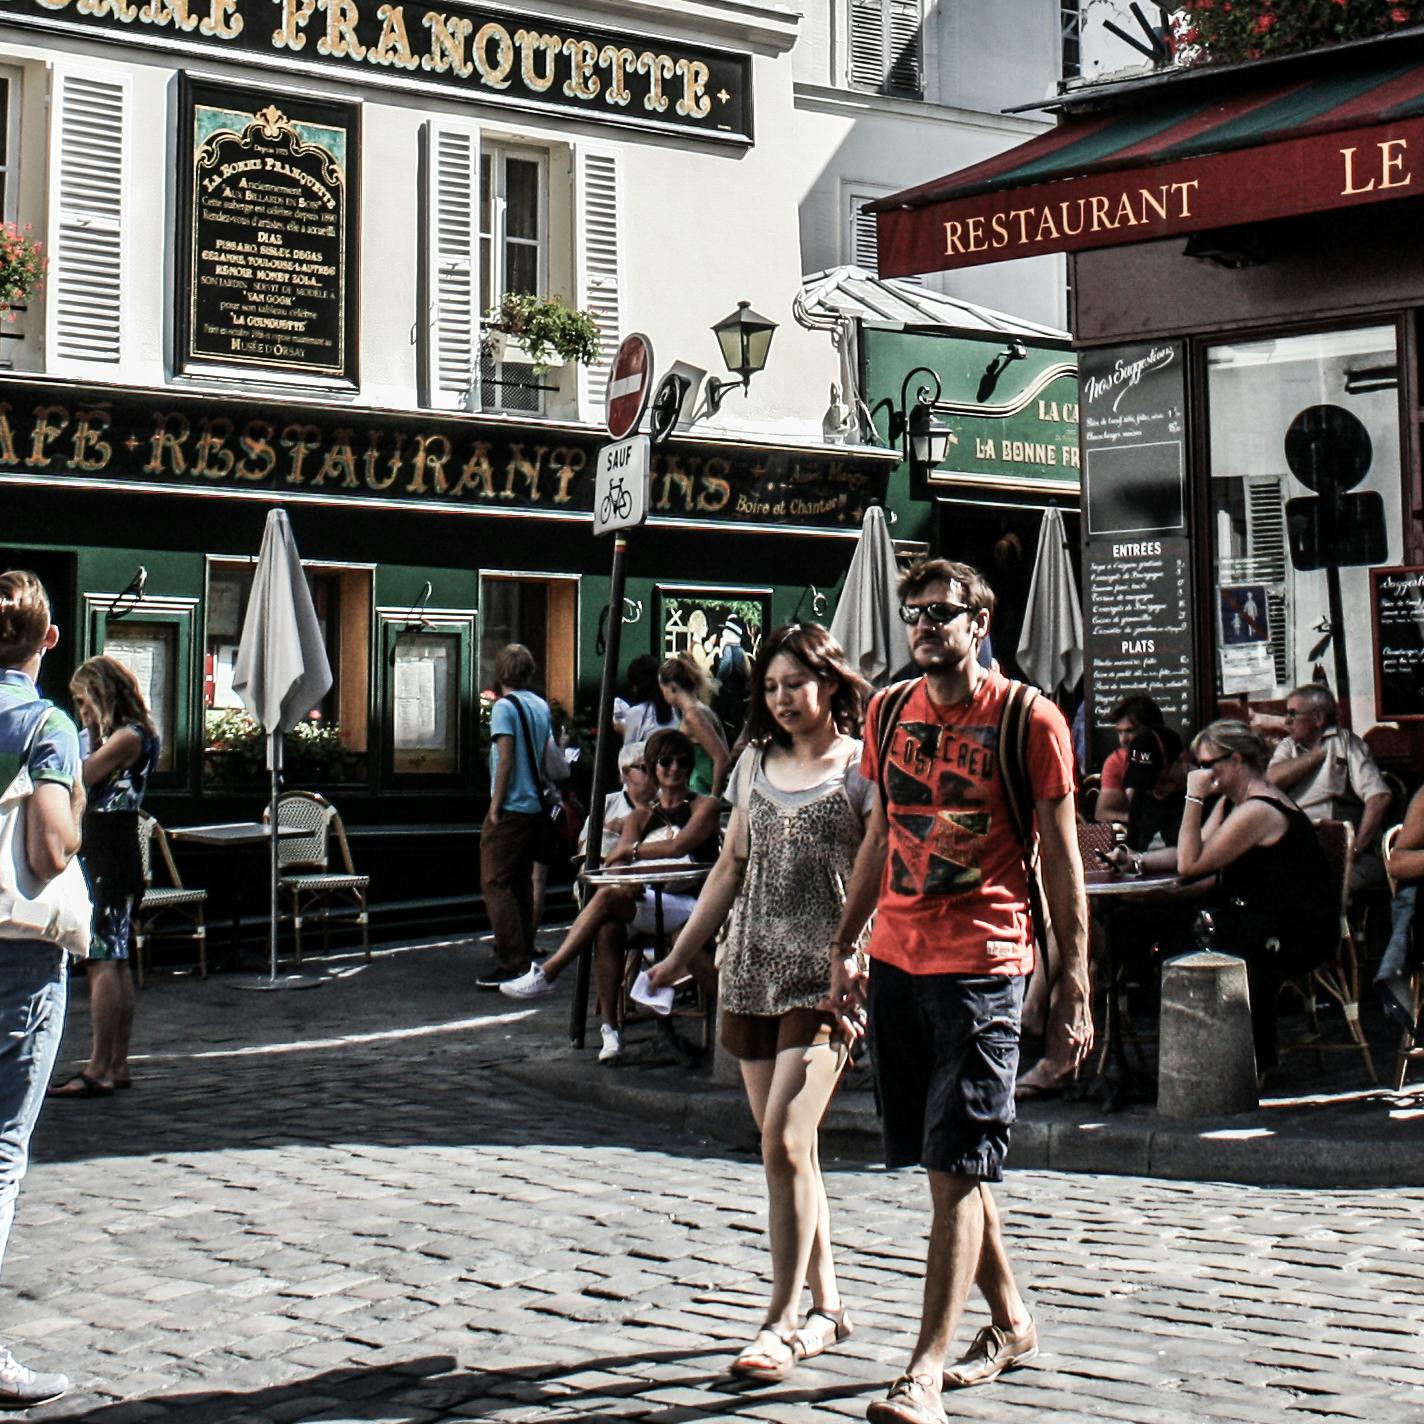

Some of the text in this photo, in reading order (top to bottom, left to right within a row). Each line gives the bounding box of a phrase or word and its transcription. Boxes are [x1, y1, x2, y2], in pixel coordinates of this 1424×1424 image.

[943, 179, 1200, 256] RESTAURANT
[1339, 136, 1413, 197] LE
[1039, 399, 1060, 423] LA
[143, 408, 588, 504] RESTAURANT
[606, 444, 632, 472] SAUF
[975, 437, 996, 460] LA
[1002, 439, 1057, 466] BONNE
[735, 493, 770, 514] Boire
[1112, 541, 1162, 558] ENTRÉES
[1121, 639, 1155, 654] PLATS
